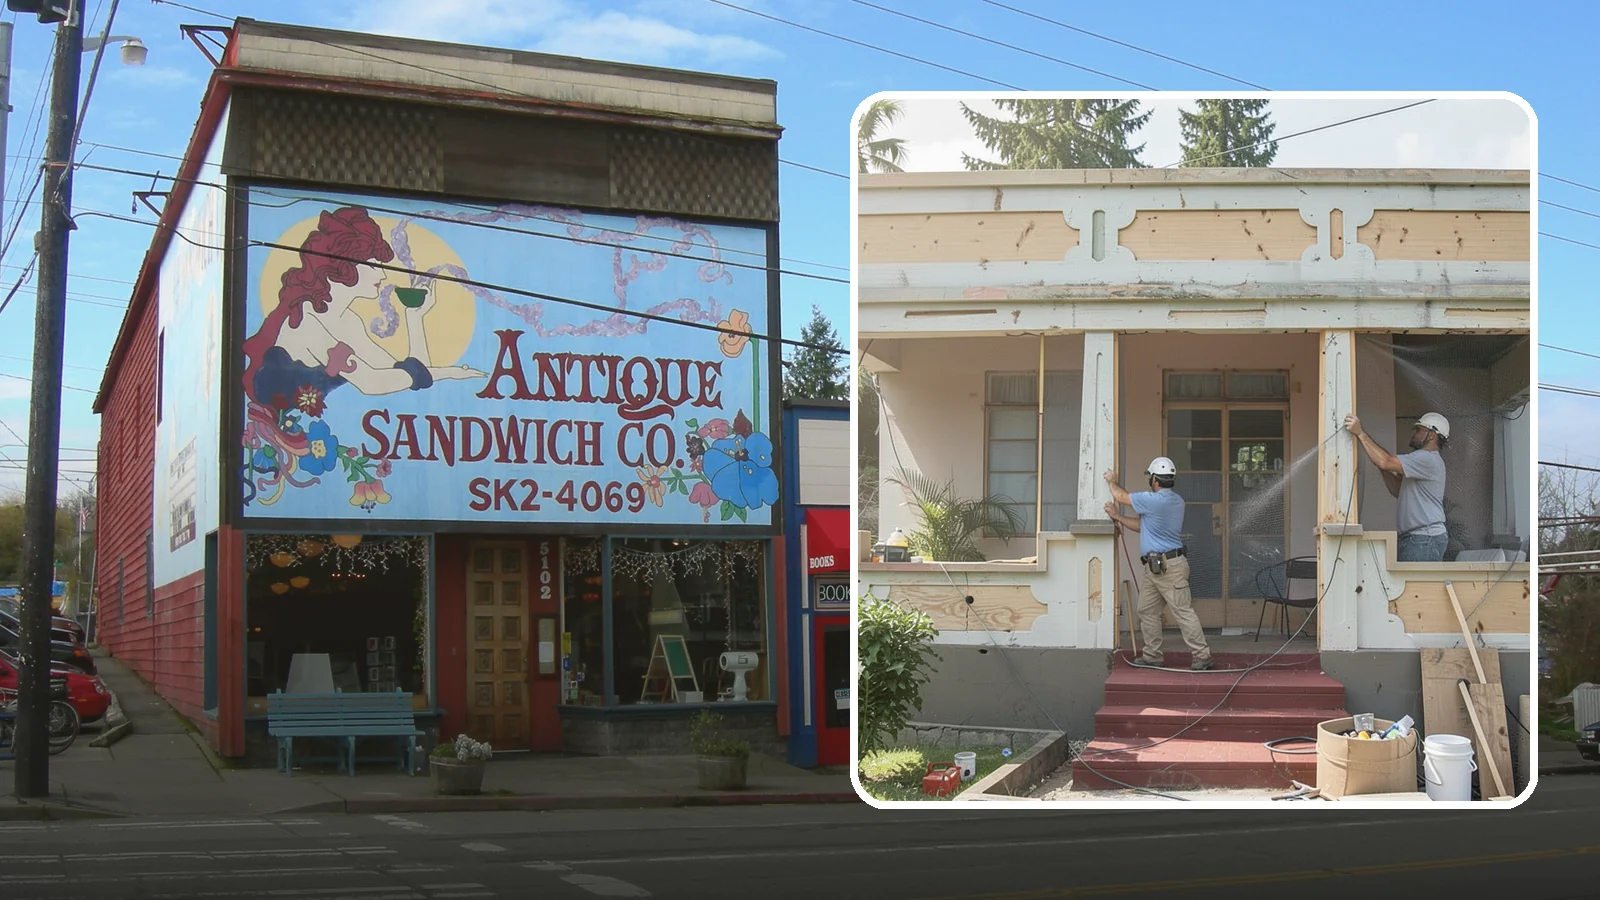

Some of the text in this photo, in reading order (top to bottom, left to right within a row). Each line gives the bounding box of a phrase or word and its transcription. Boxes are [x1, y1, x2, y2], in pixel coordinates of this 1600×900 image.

[476, 329, 723, 420] ANTIQUE
[361, 408, 685, 468] SANDWICH CO.
[468, 476, 646, 513] SK2-4069
[540, 541, 551, 600] 5102
[809, 555, 835, 569] BOOKS
